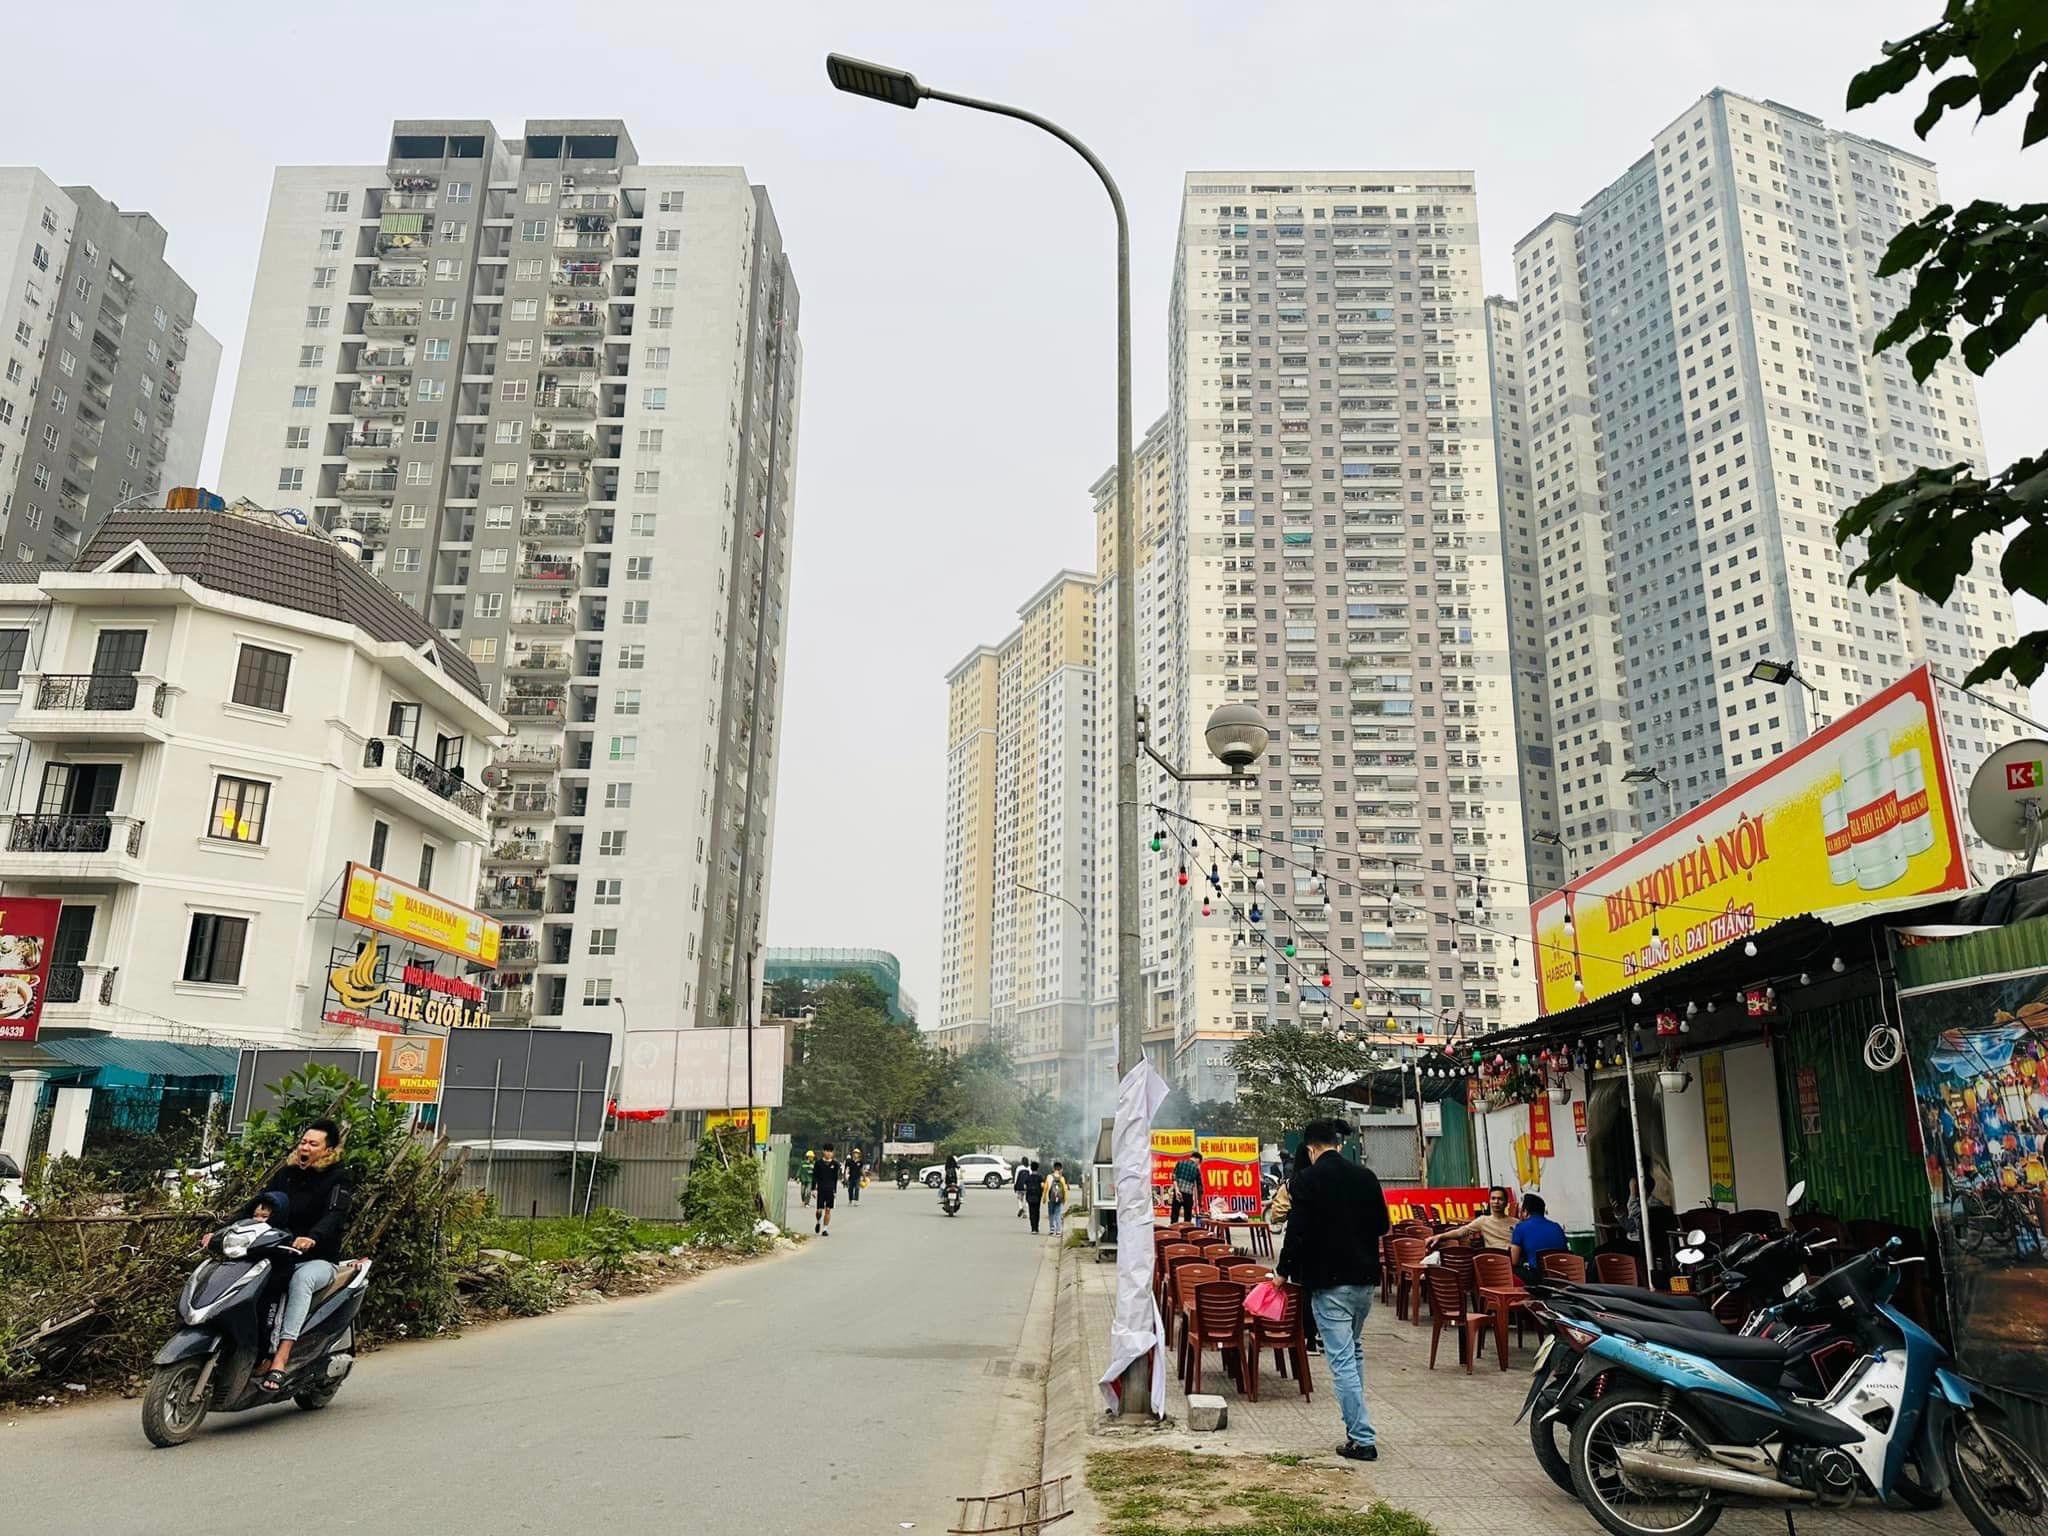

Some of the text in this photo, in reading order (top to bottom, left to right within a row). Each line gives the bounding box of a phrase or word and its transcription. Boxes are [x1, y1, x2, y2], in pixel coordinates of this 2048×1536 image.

[1605, 885, 1640, 933] BIA
[1677, 834, 1718, 900] HÀ
[1714, 811, 1770, 882] NỘI
[1673, 934, 1684, 957] &
[1546, 961, 1573, 984] HABECO
[1207, 1164, 1253, 1190] VỊT CỎ
